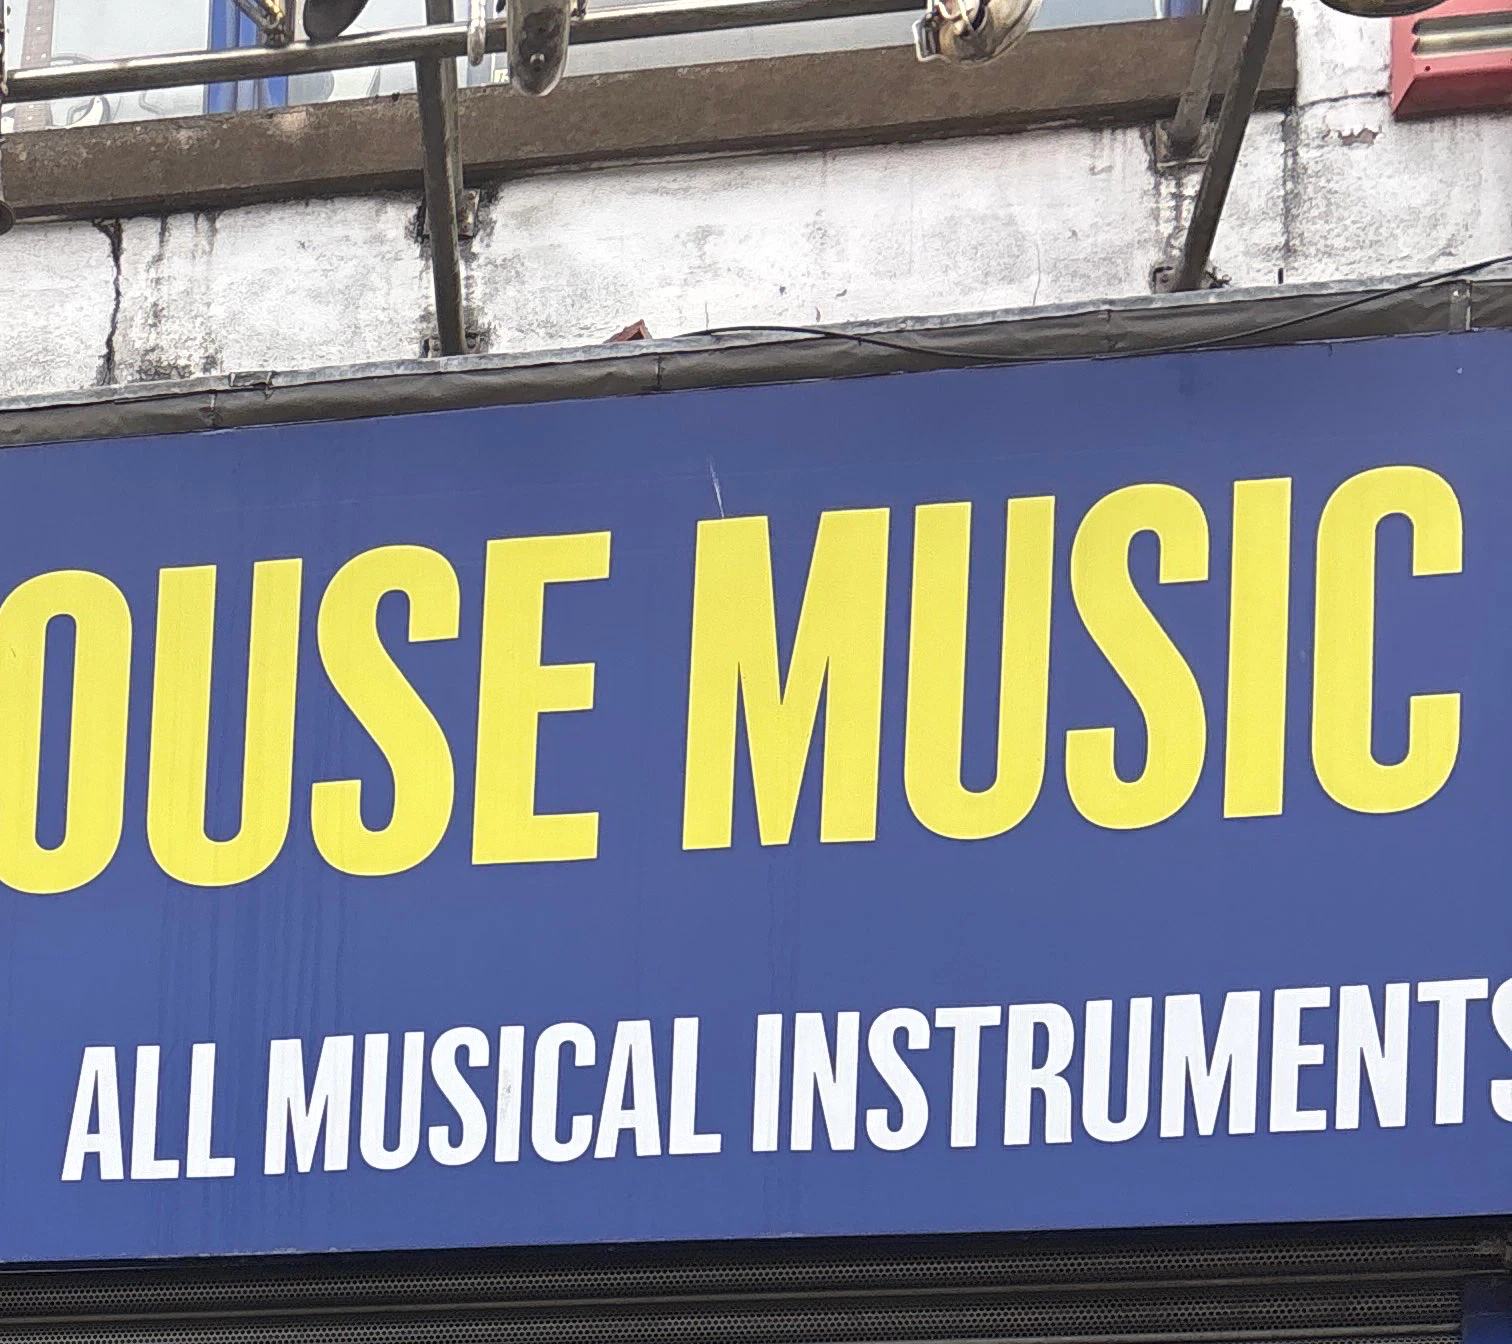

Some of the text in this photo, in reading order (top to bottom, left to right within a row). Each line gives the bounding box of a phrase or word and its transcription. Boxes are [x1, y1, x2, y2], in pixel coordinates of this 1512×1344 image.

[682, 465, 1463, 851] MUSIC
[61, 1043, 236, 1181] ALL
[264, 1016, 722, 1175] MUSICAL
